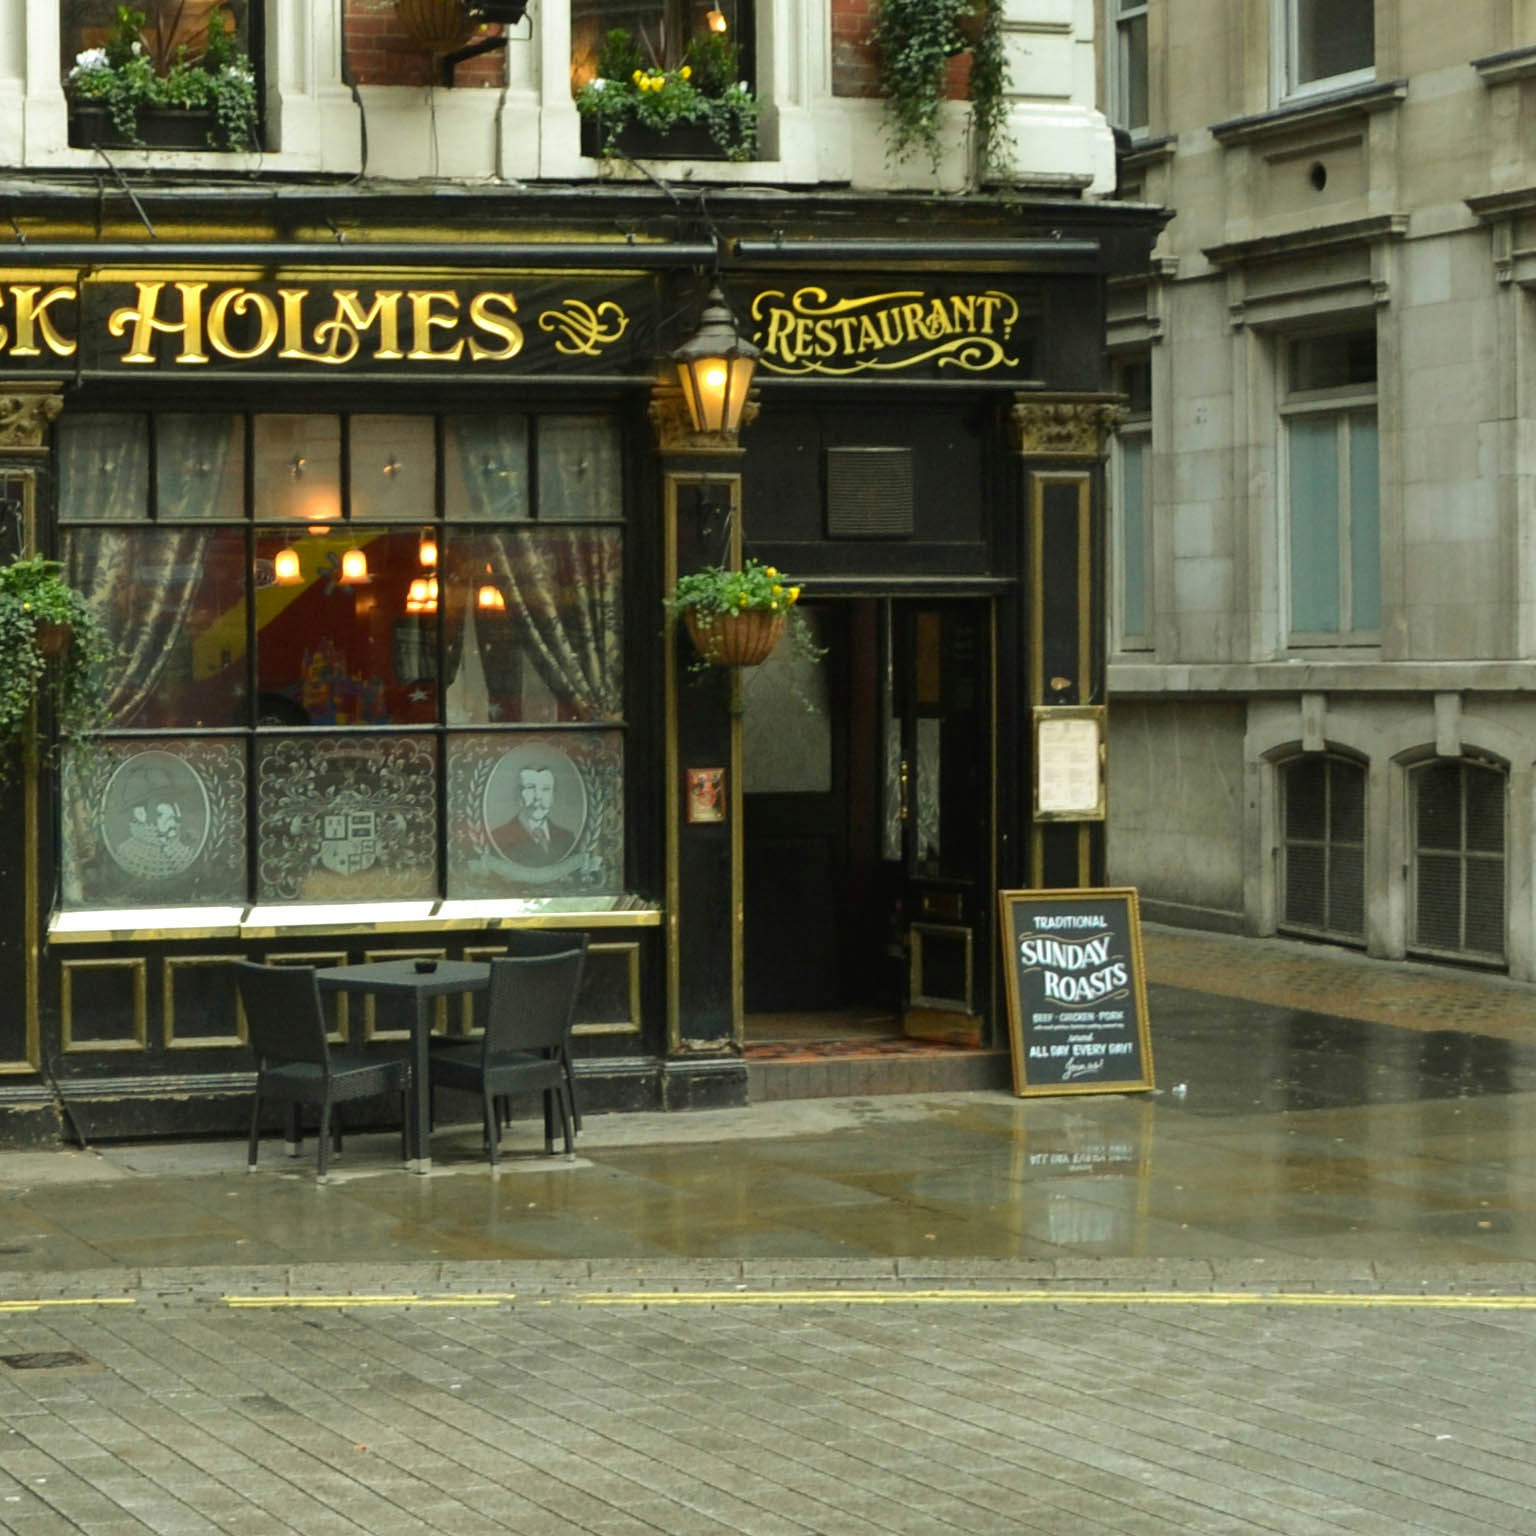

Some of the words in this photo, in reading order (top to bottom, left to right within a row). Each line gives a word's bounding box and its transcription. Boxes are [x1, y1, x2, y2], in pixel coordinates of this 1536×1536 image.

[107, 280, 525, 364] HOLMES
[766, 295, 1002, 364] RESTAURANT
[1033, 915, 1108, 930] TRADITIONAL
[1020, 936, 1111, 970] SUNDAY
[1043, 962, 1128, 1002] ROASTS
[1029, 1045, 1049, 1058] ALL
[1072, 1043, 1106, 1057] EVERY
